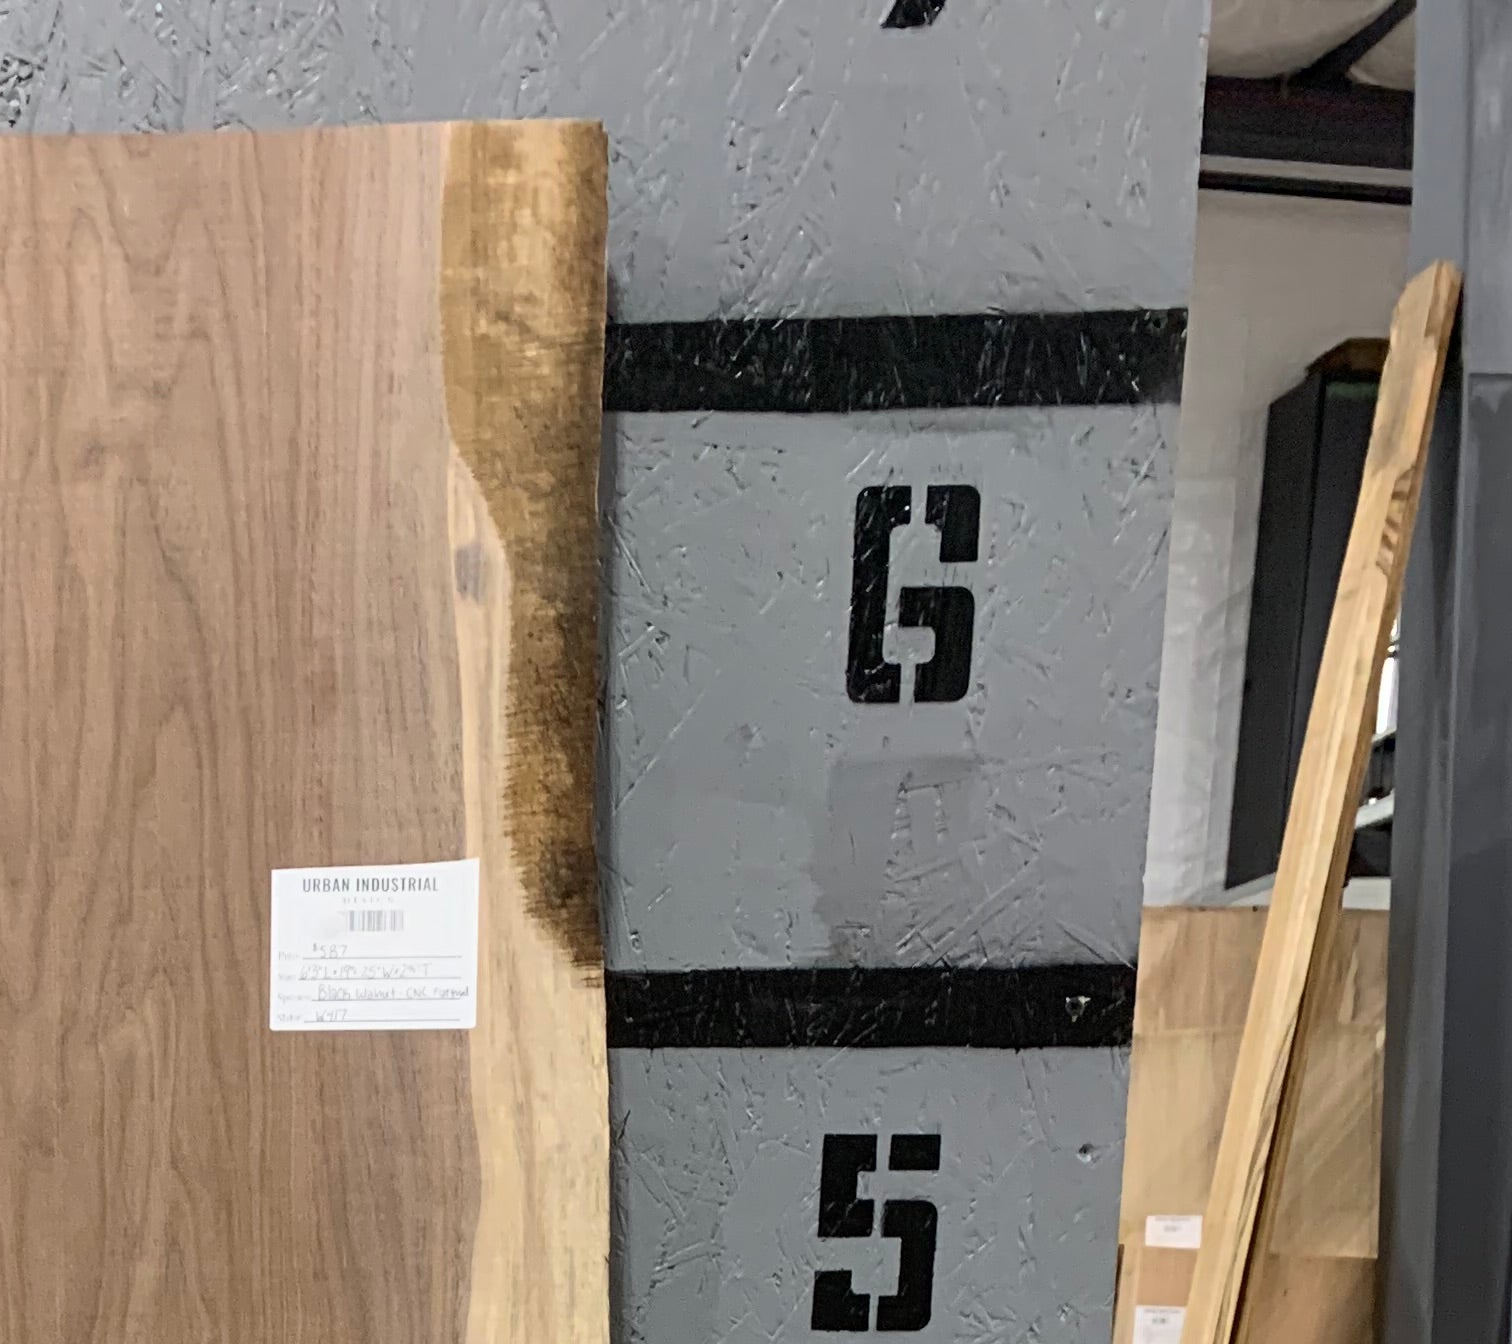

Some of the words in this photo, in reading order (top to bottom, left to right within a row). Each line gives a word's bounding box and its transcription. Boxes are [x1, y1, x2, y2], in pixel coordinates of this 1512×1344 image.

[846, 485, 980, 704] 6
[303, 878, 350, 893] URBAN
[356, 876, 439, 893] INDUSTRIAL
[811, 1134, 941, 1332] 5
